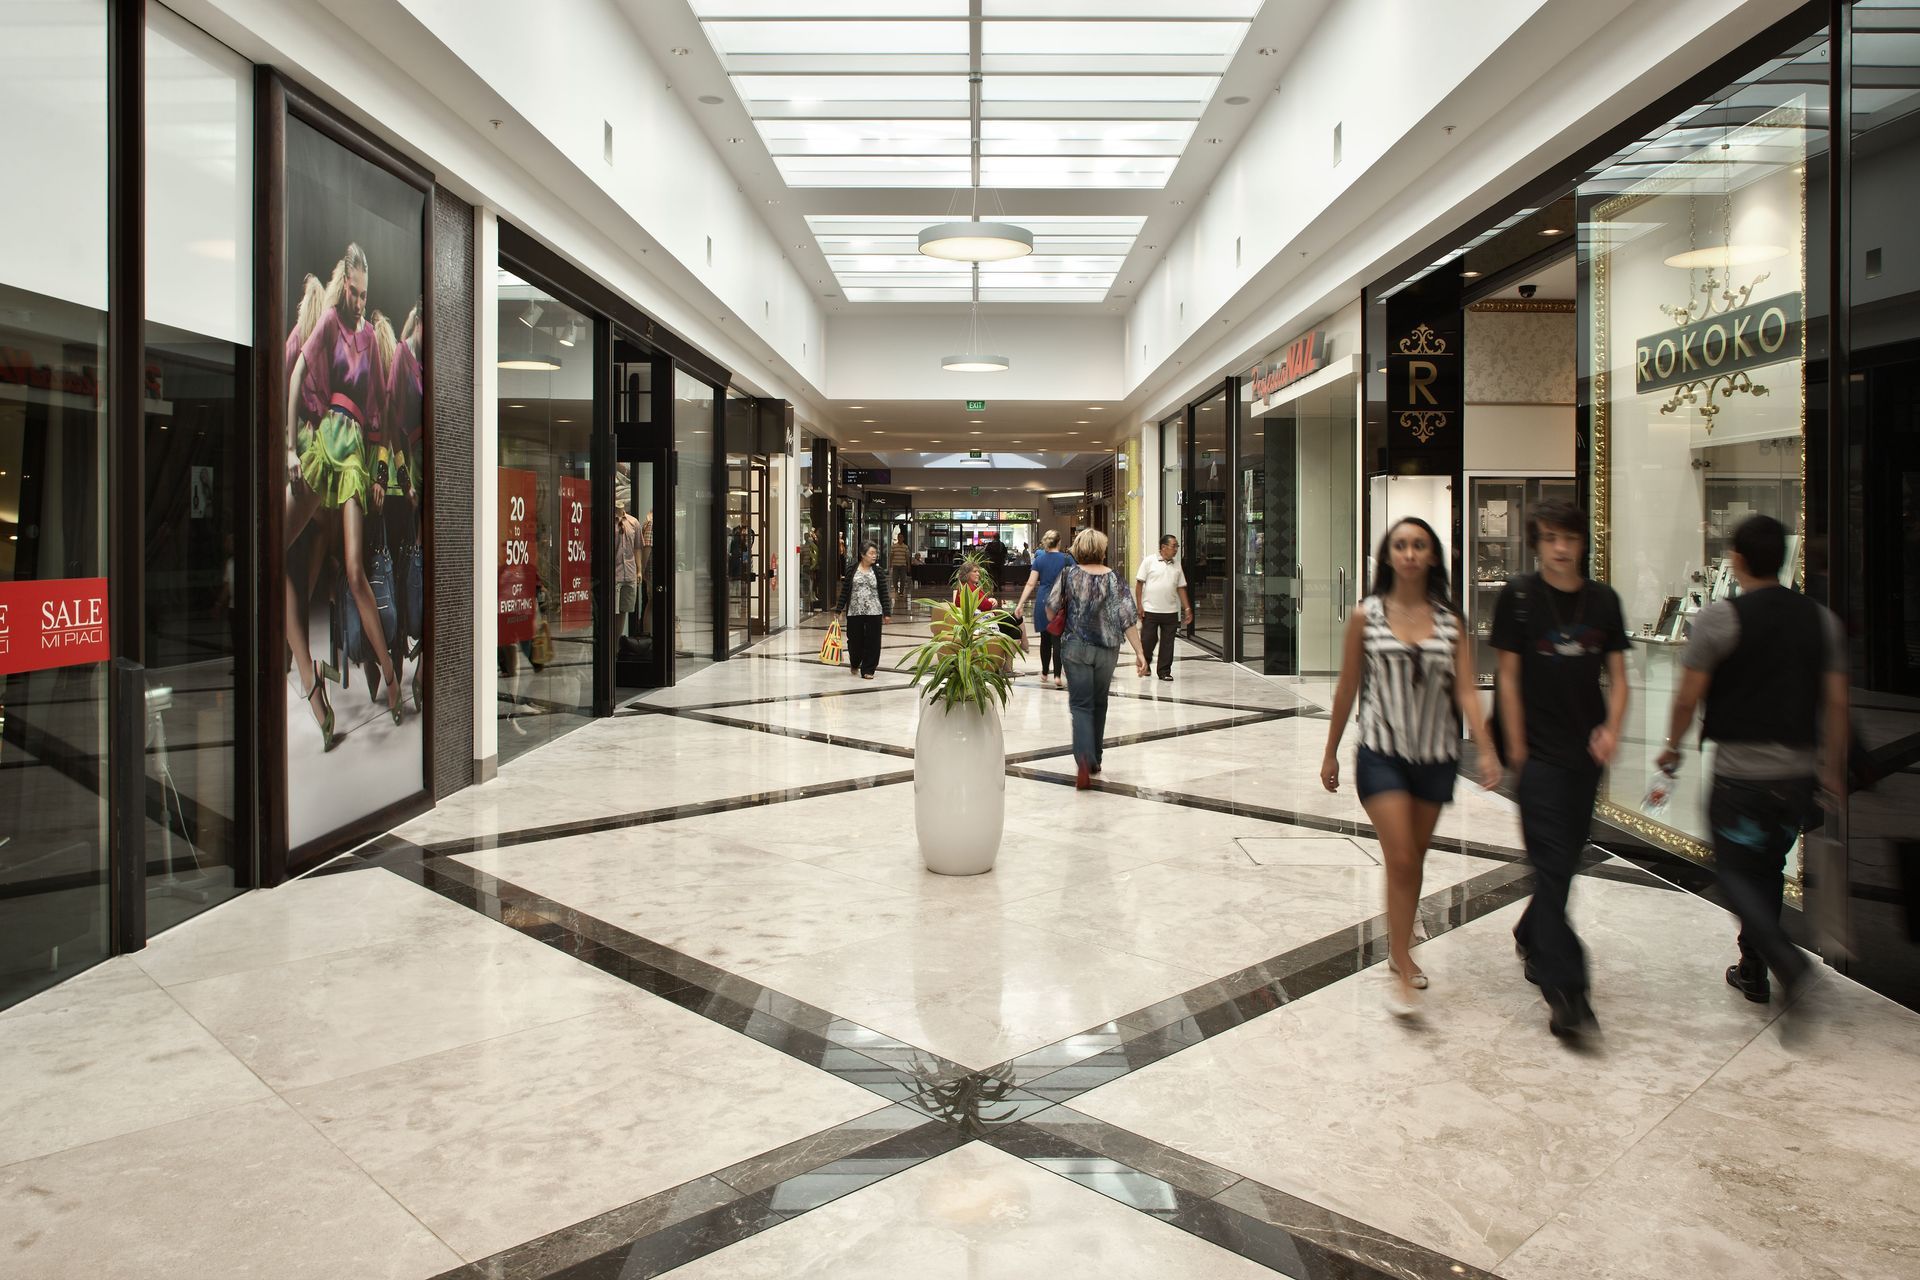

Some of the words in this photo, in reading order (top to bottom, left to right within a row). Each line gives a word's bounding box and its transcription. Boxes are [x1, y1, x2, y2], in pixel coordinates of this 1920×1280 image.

[1637, 307, 1786, 384] ROKOKO
[1409, 361, 1438, 405] R
[510, 496, 525, 521] 20
[571, 502, 582, 523] 20
[514, 527, 520, 536] to
[574, 528, 579, 537] to
[506, 540, 529, 566] 50%
[568, 540, 586, 562] 50%
[512, 583, 523, 596] OFF
[572, 578, 581, 588] OFF
[501, 598, 532, 613] EVERYTHING
[563, 590, 589, 604] EVERYTHING
[41, 598, 103, 631] SALE
[41, 635, 60, 649] MI
[64, 629, 103, 646] PIACI
